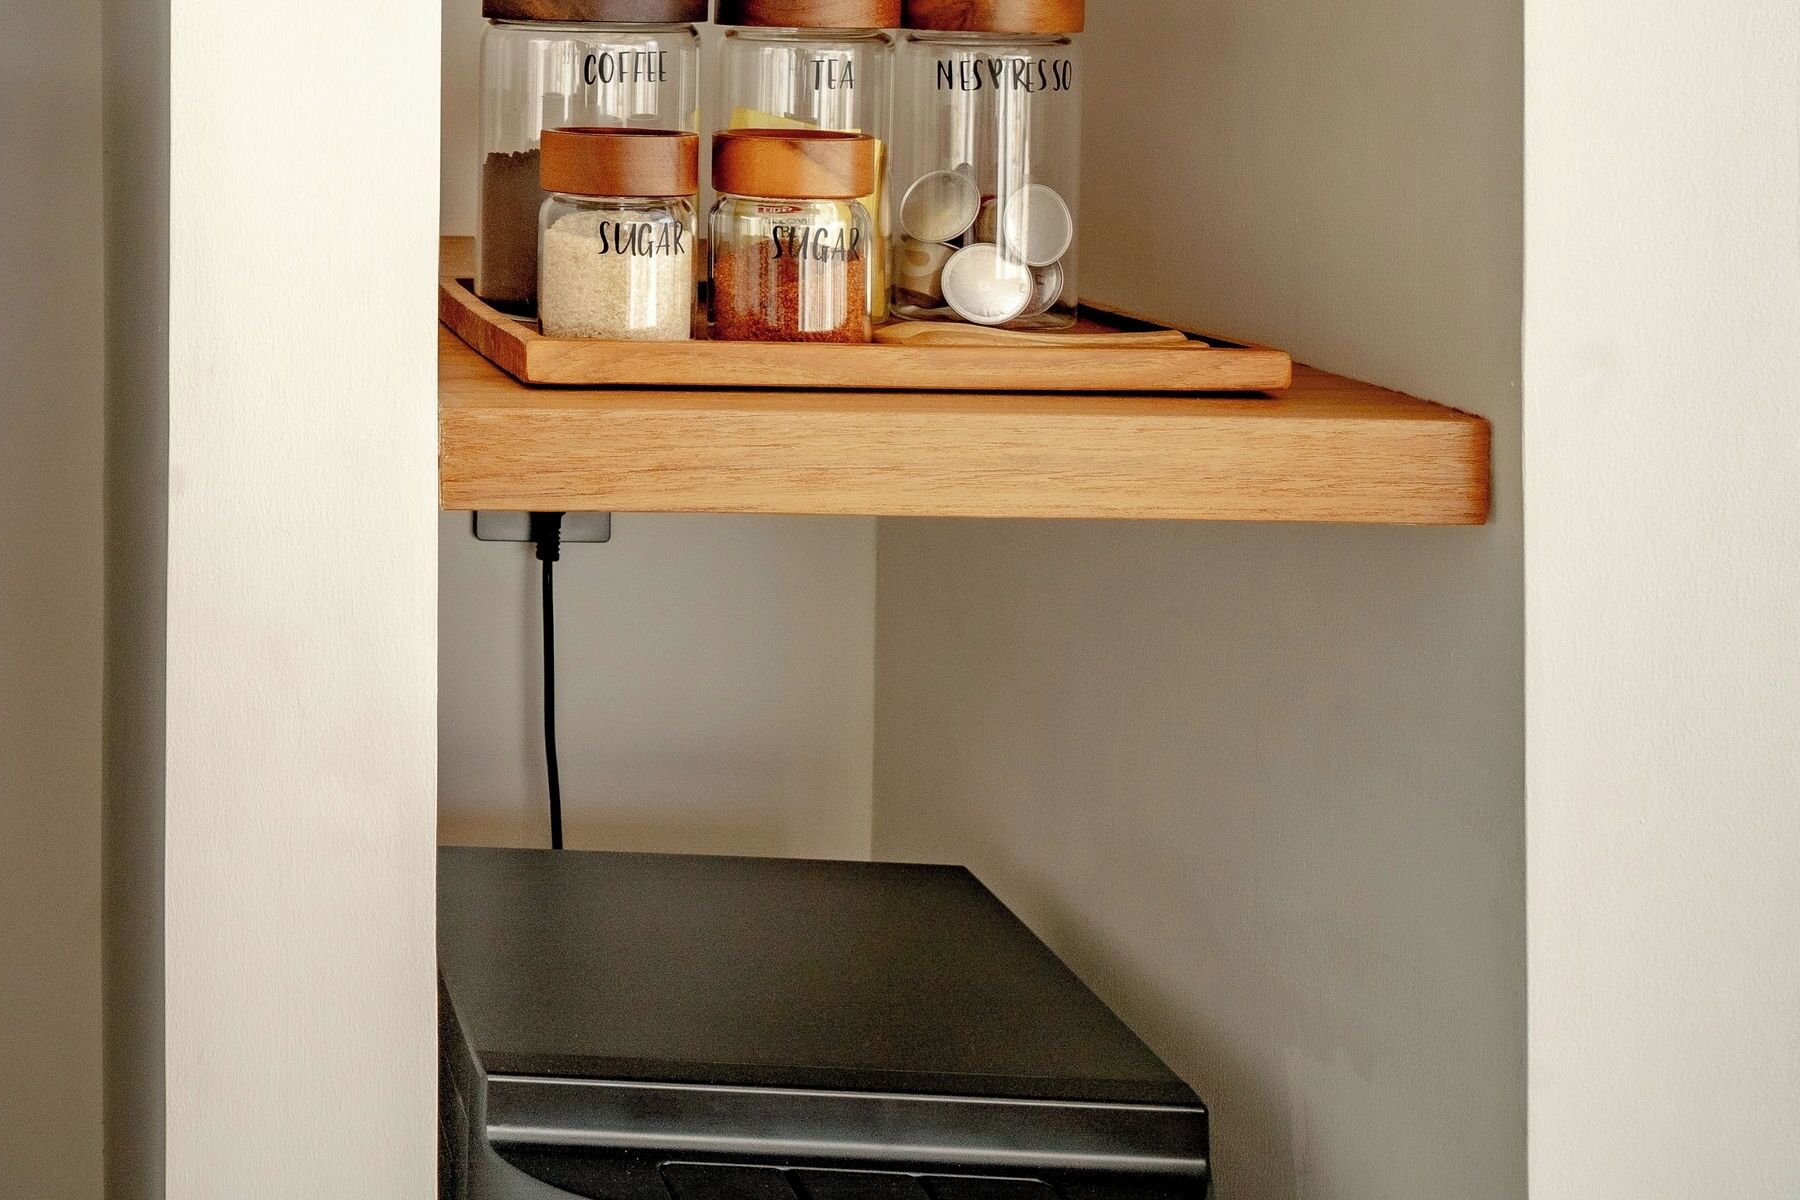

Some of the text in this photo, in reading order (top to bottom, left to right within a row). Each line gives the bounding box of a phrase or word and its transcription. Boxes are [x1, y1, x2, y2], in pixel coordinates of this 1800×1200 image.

[584, 50, 668, 85] COFFEE
[810, 58, 854, 90] TEA
[937, 58, 1073, 93] NESPRESSO
[597, 220, 685, 258] SUGAR
[771, 225, 860, 263] SUGAR
